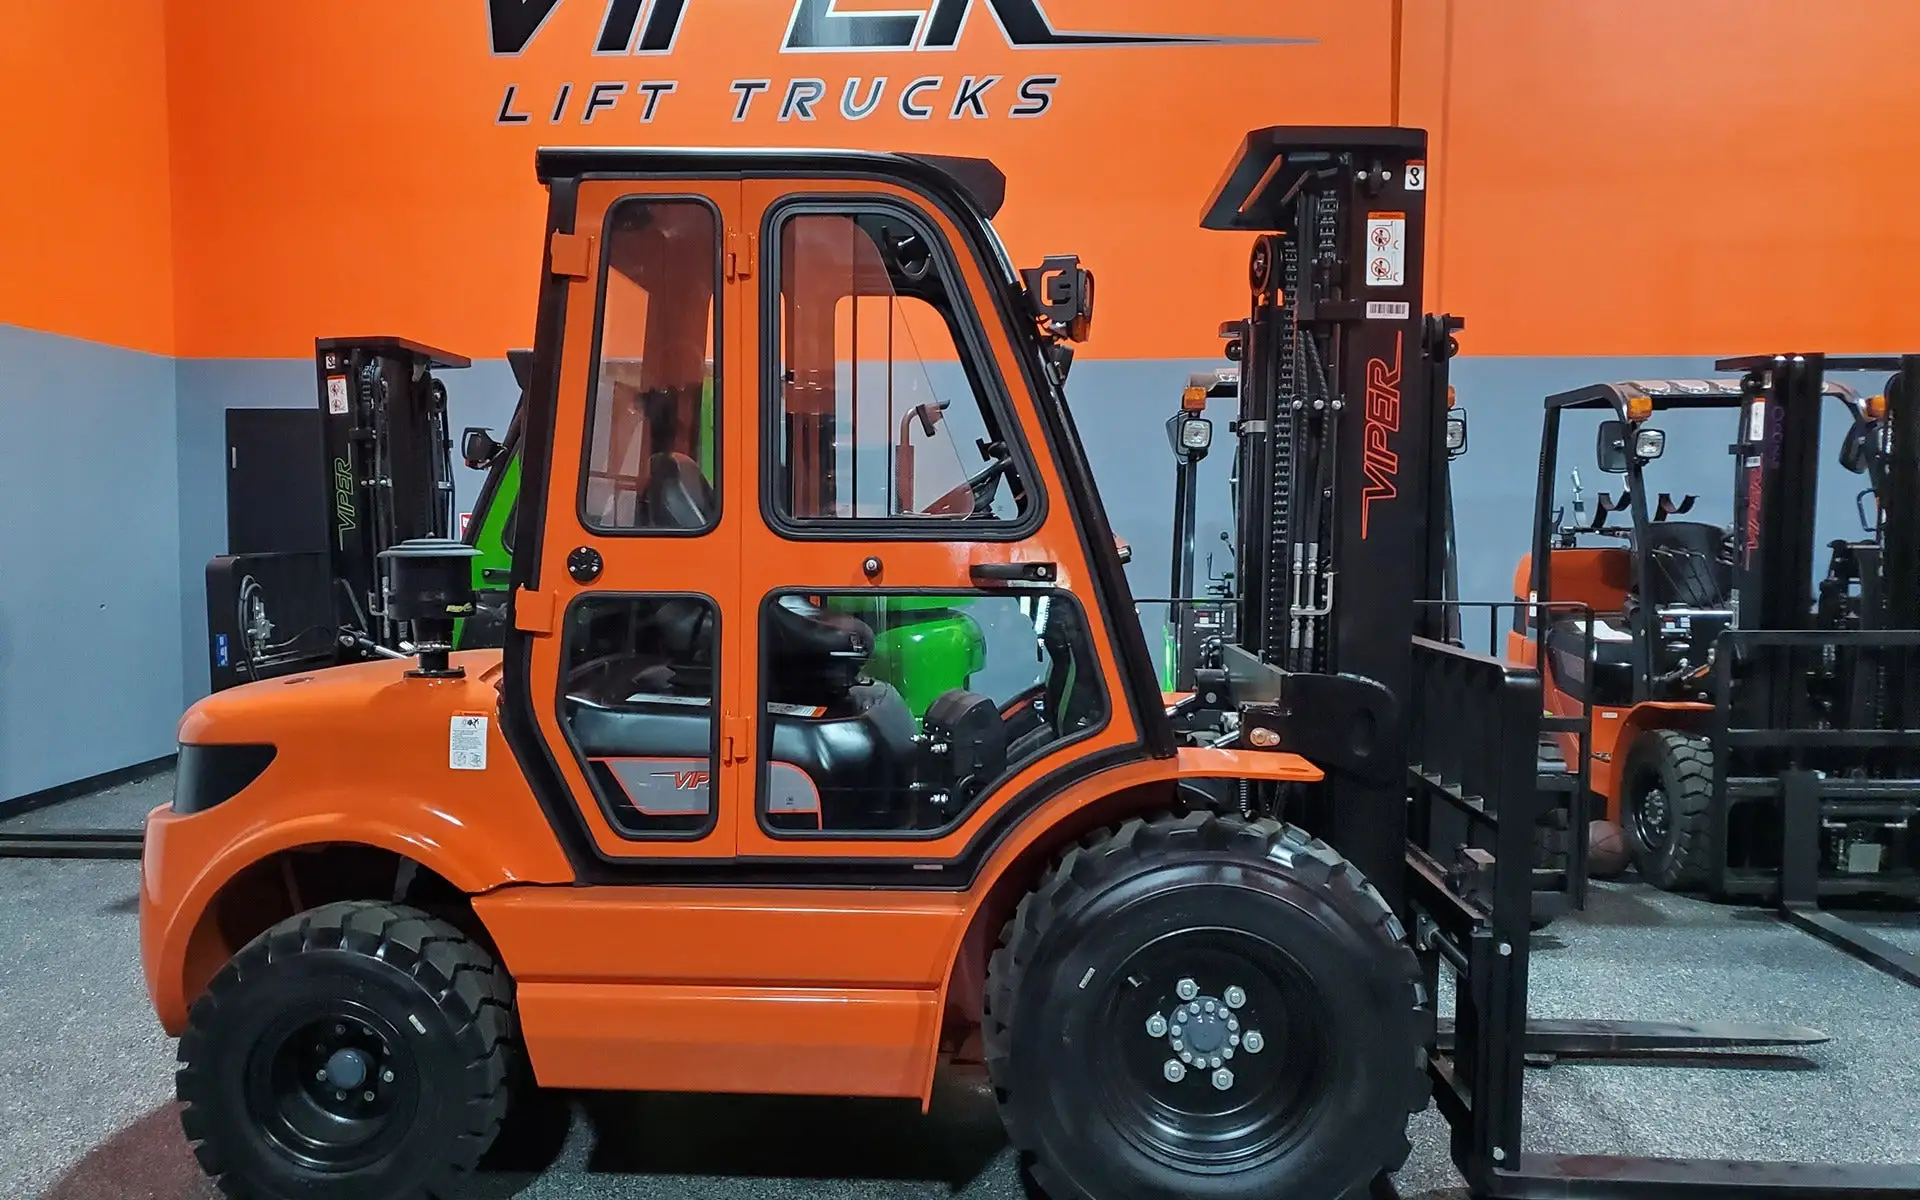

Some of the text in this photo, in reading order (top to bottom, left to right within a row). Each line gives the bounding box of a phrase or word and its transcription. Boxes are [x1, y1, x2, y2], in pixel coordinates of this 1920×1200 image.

[495, 74, 1061, 126] LIFT TRUCKS
[1361, 331, 1402, 540] VIPER
[335, 442, 356, 552] VIPER
